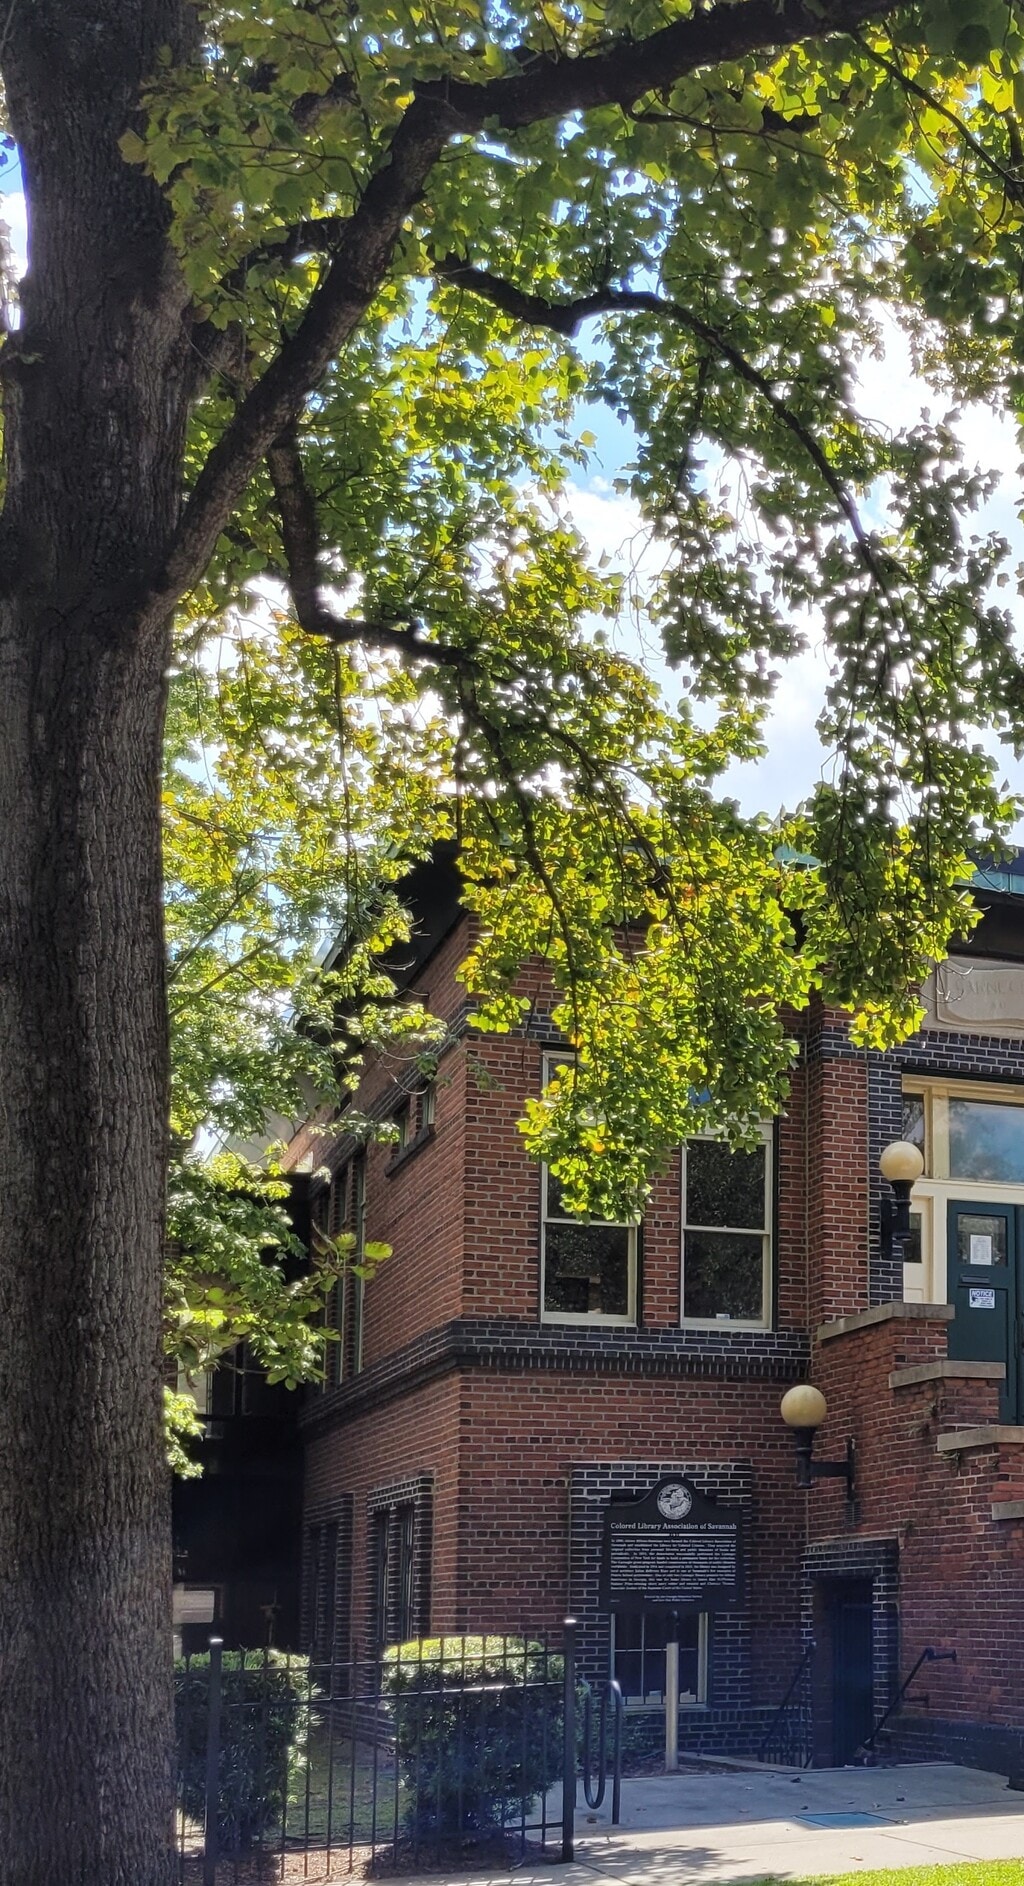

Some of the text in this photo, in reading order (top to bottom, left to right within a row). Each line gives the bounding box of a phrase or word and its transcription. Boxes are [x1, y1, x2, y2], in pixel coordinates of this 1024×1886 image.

[610, 1522, 636, 1530] Colored
[637, 1522, 661, 1531] Library
[662, 1522, 699, 1530] Association
[707, 1522, 737, 1530] Savannah
